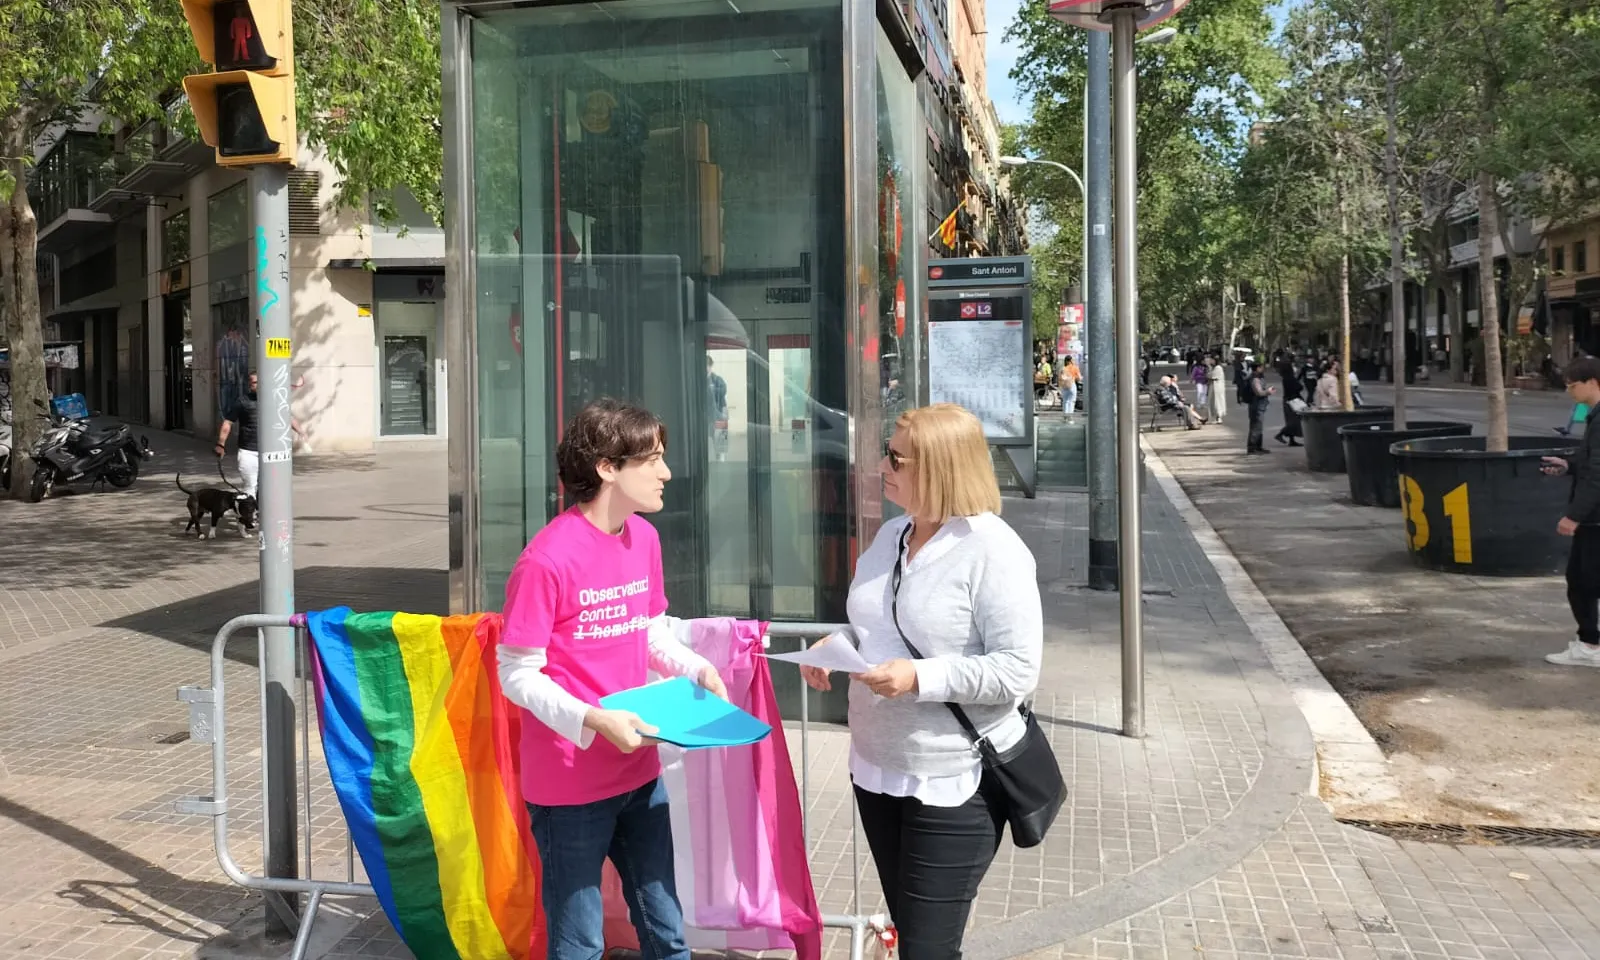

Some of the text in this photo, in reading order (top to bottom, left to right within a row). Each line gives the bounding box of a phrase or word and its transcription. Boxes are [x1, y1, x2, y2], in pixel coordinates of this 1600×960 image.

[972, 266, 1017, 275] Sant Antoni
[977, 305, 991, 314] L2
[579, 603, 628, 623] contra
